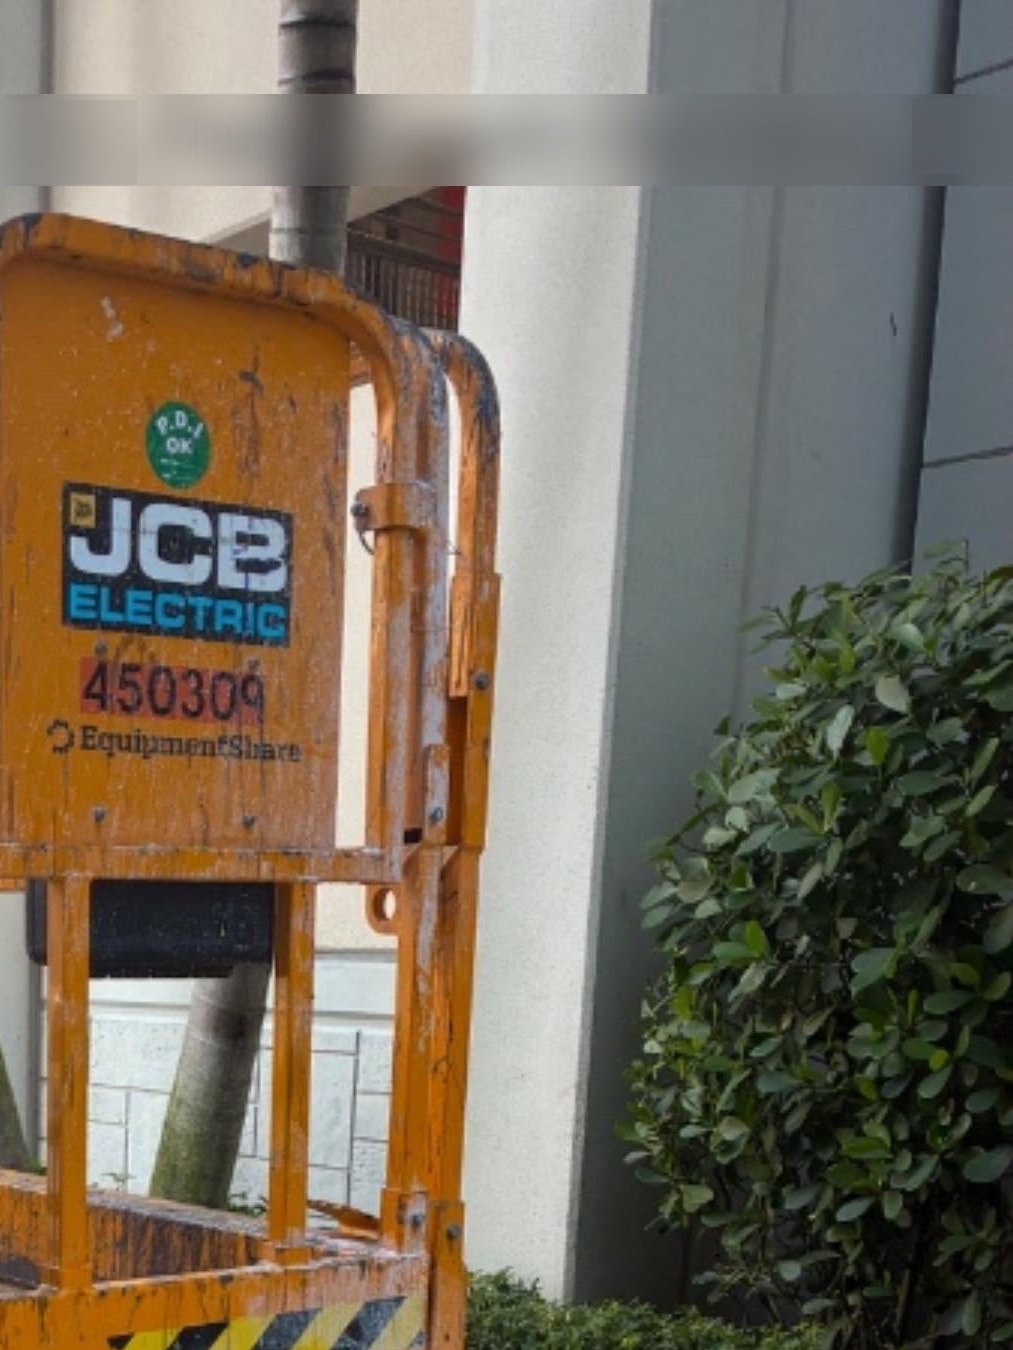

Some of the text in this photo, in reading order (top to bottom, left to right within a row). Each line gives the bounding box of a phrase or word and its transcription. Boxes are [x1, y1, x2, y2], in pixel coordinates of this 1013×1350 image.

[166, 437, 193, 454] OK
[69, 497, 288, 593] JCB
[69, 582, 286, 638] ELECTRIC
[84, 660, 265, 724] 450309
[80, 725, 302, 762] EquipmentShare
